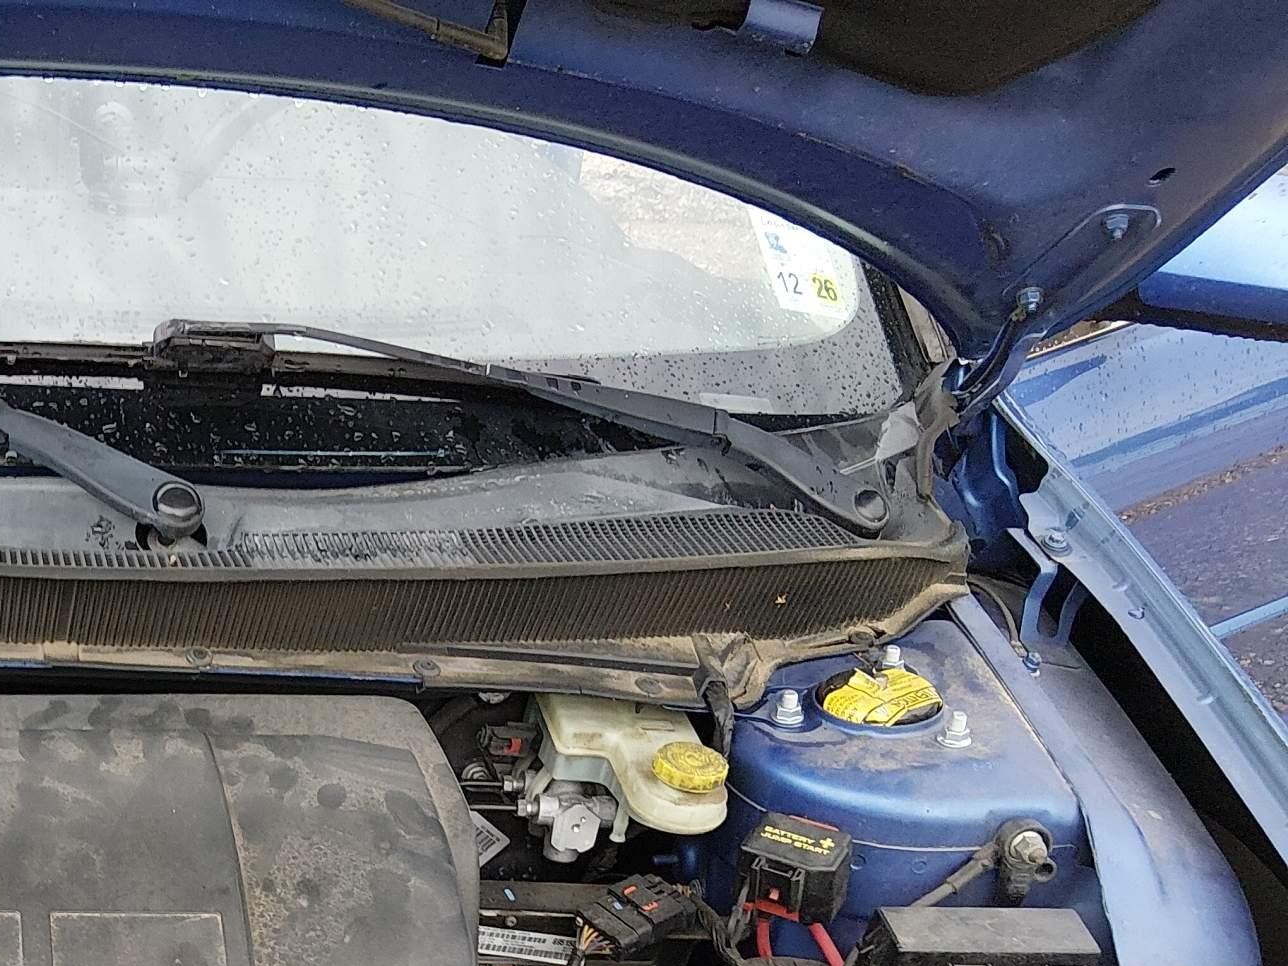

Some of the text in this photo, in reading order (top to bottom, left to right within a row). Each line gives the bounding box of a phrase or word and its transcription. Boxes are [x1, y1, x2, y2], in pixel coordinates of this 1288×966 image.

[776, 271, 839, 302] 12 26
[760, 832, 830, 856] JUMP START
[764, 825, 816, 844] BATTERY
